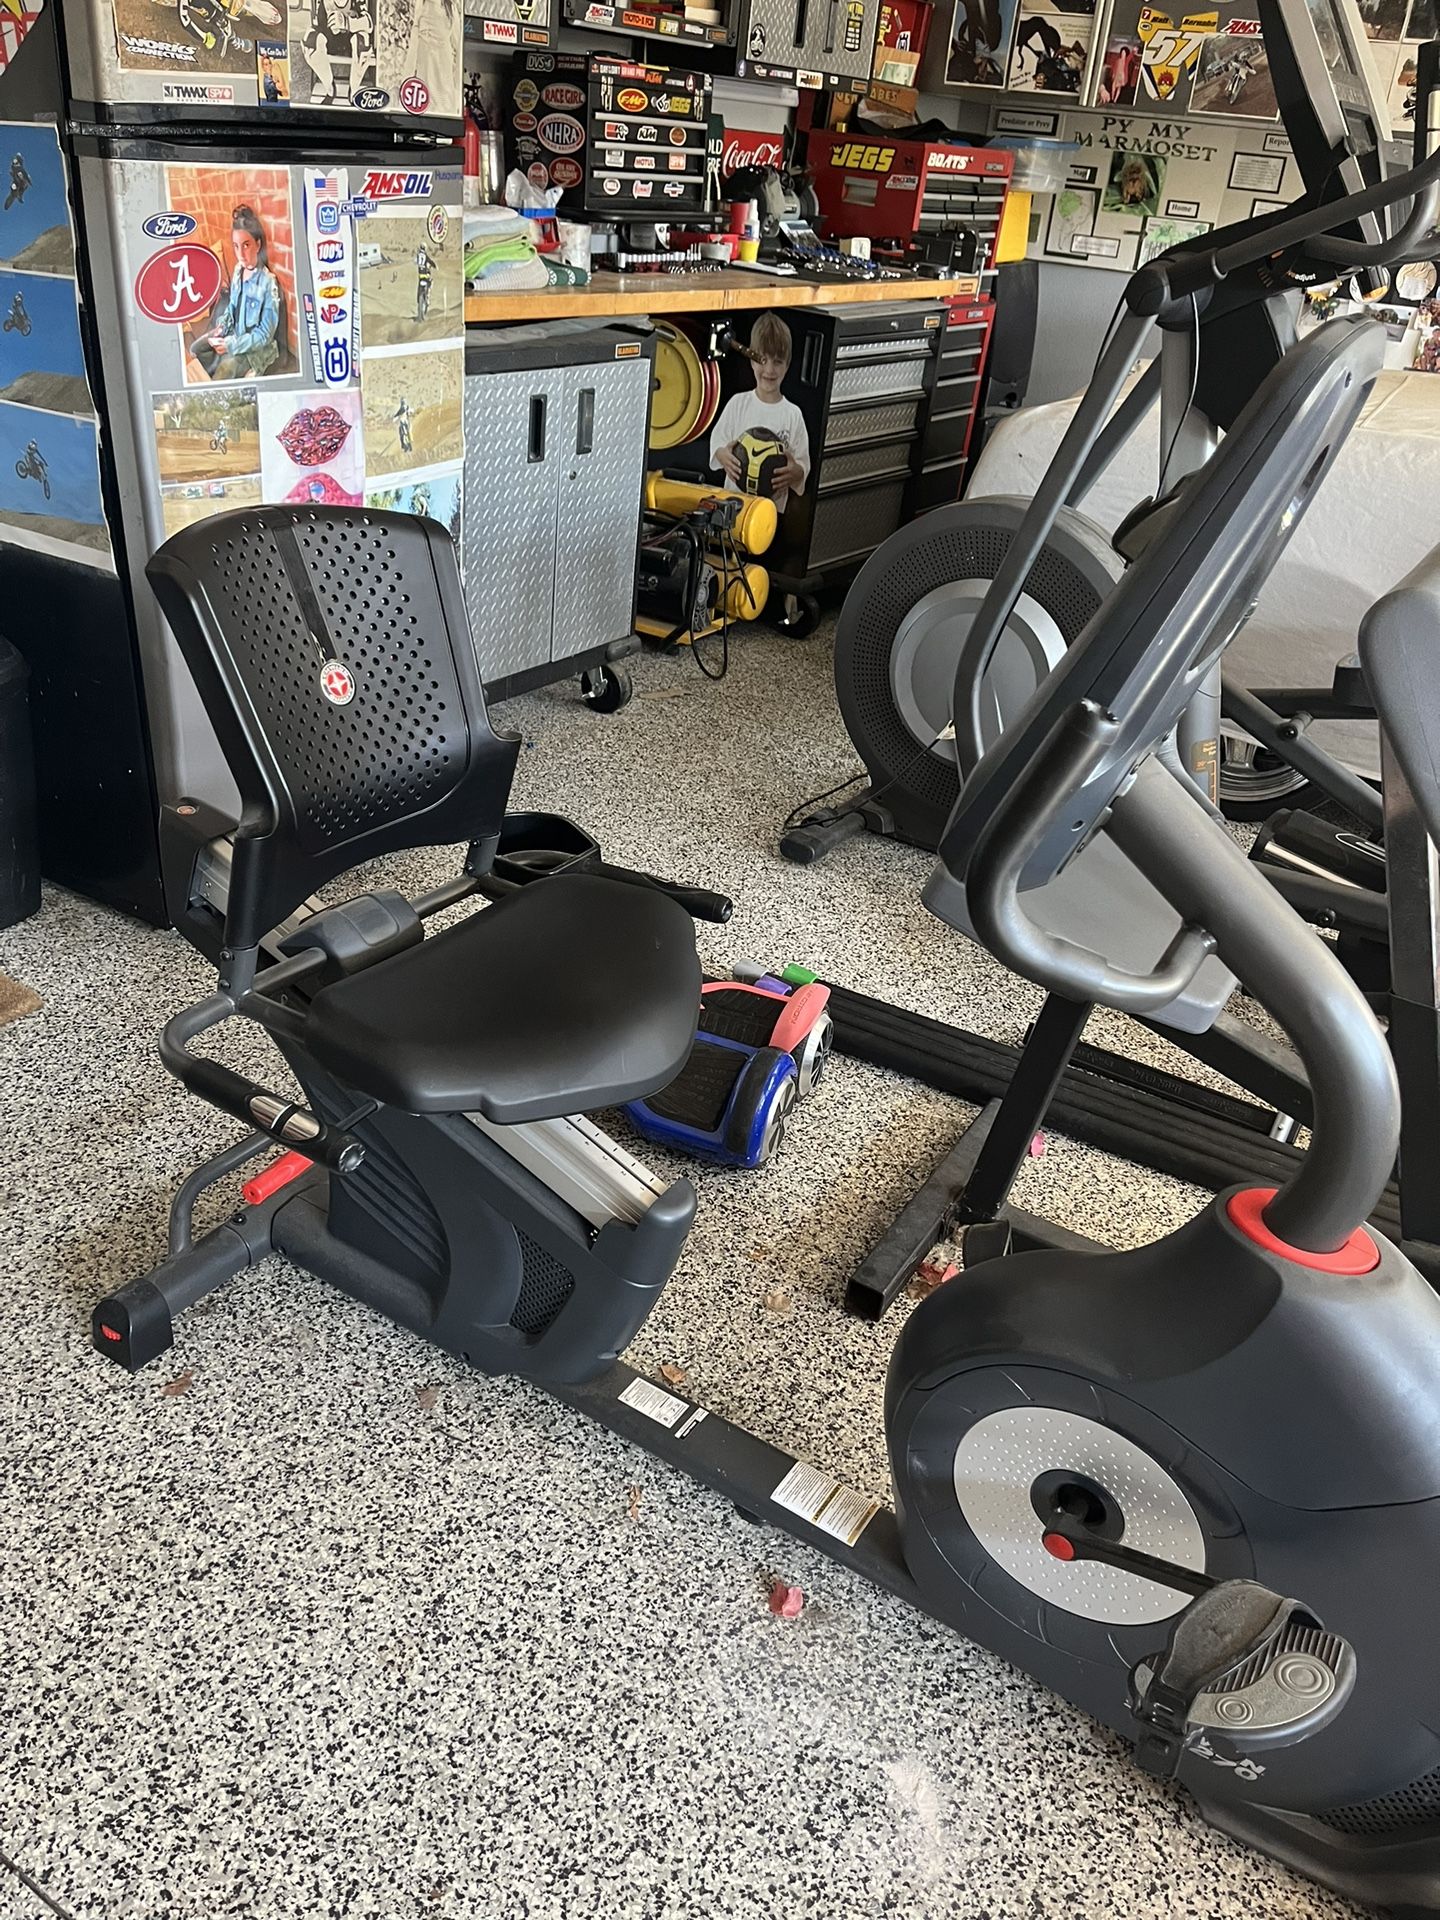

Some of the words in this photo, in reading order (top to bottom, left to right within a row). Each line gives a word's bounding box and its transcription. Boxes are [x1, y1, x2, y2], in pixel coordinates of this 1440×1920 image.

[1222, 20, 1261, 36] AMS
[121, 35, 197, 54] WORKS
[1143, 30, 1206, 67] 57
[126, 46, 197, 62] CONNECTION
[528, 55, 544, 69] DVS
[361, 91, 384, 108] Ford
[405, 82, 427, 108] STP
[545, 88, 564, 104] RACE
[620, 95, 645, 106] FMF
[545, 123, 577, 144] NHRA
[1148, 122, 1191, 141] MY
[1074, 131, 1217, 162] MARMOSET
[1268, 137, 1289, 146] Repor
[831, 143, 895, 172] JEGS
[362, 173, 431, 198] AMSOIL
[342, 203, 377, 212] CHEVROLET
[1171, 204, 1192, 212] Home
[155, 216, 187, 235] Ford
[318, 243, 343, 260] 100%
